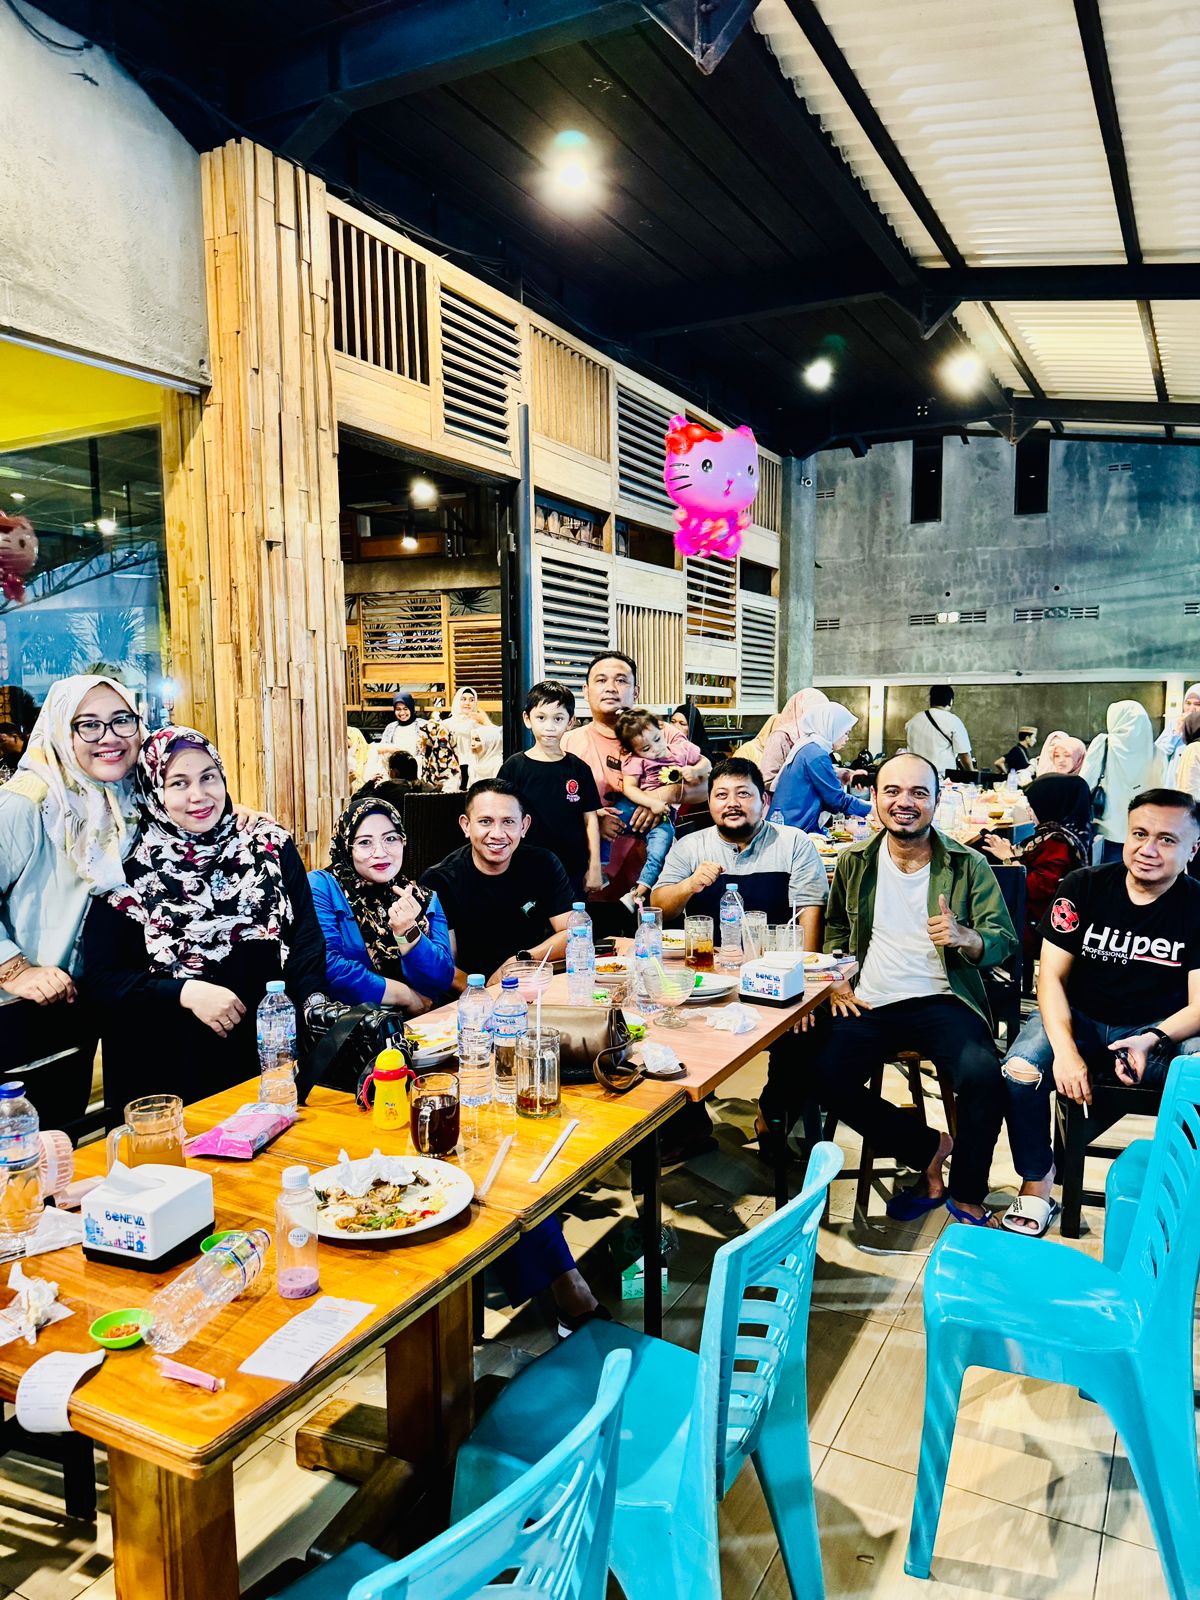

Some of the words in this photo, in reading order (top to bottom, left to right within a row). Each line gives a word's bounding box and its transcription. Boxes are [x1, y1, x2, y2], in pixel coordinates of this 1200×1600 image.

[1082, 923, 1186, 961] Hüper
[1081, 945, 1129, 960] PROFESSIONAL
[105, 1210, 146, 1227] BONEVA
